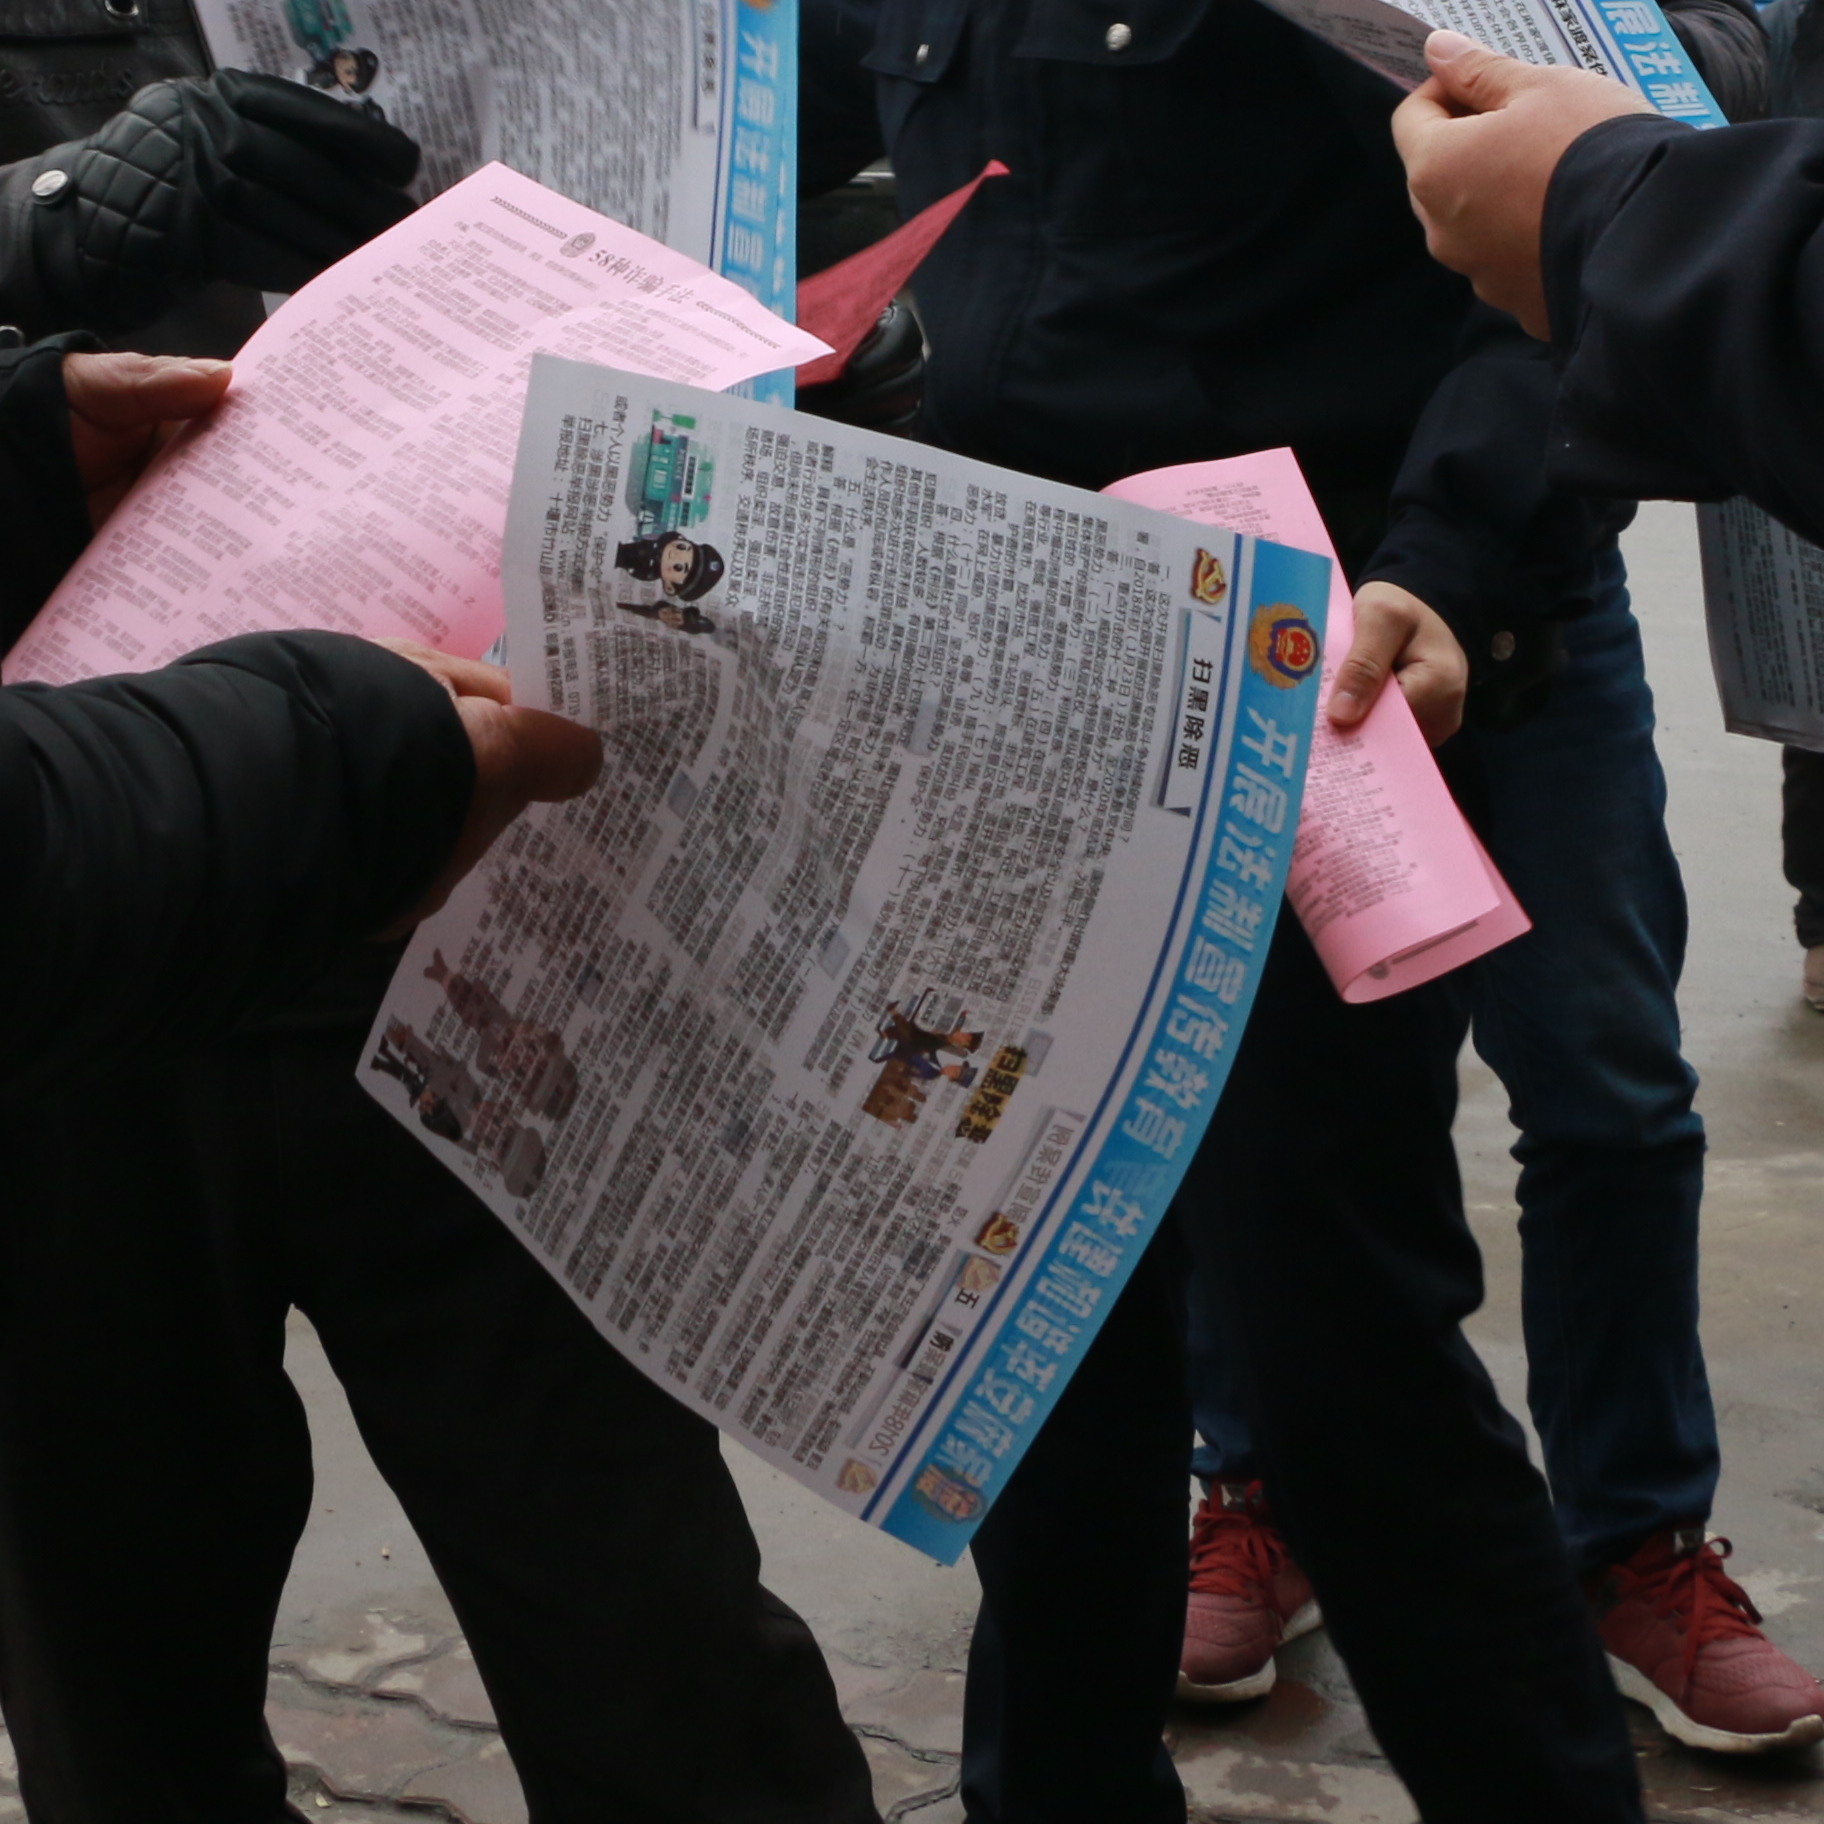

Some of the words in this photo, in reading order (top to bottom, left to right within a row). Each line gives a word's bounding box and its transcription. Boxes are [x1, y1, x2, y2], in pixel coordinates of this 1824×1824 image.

[729, 30, 778, 288] 开展法制宣
[1178, 656, 1212, 770] 扫黑除恶
[1122, 704, 1303, 1162] 开展法制宣传教育
[956, 1044, 1026, 1142] 扫黑除恶
